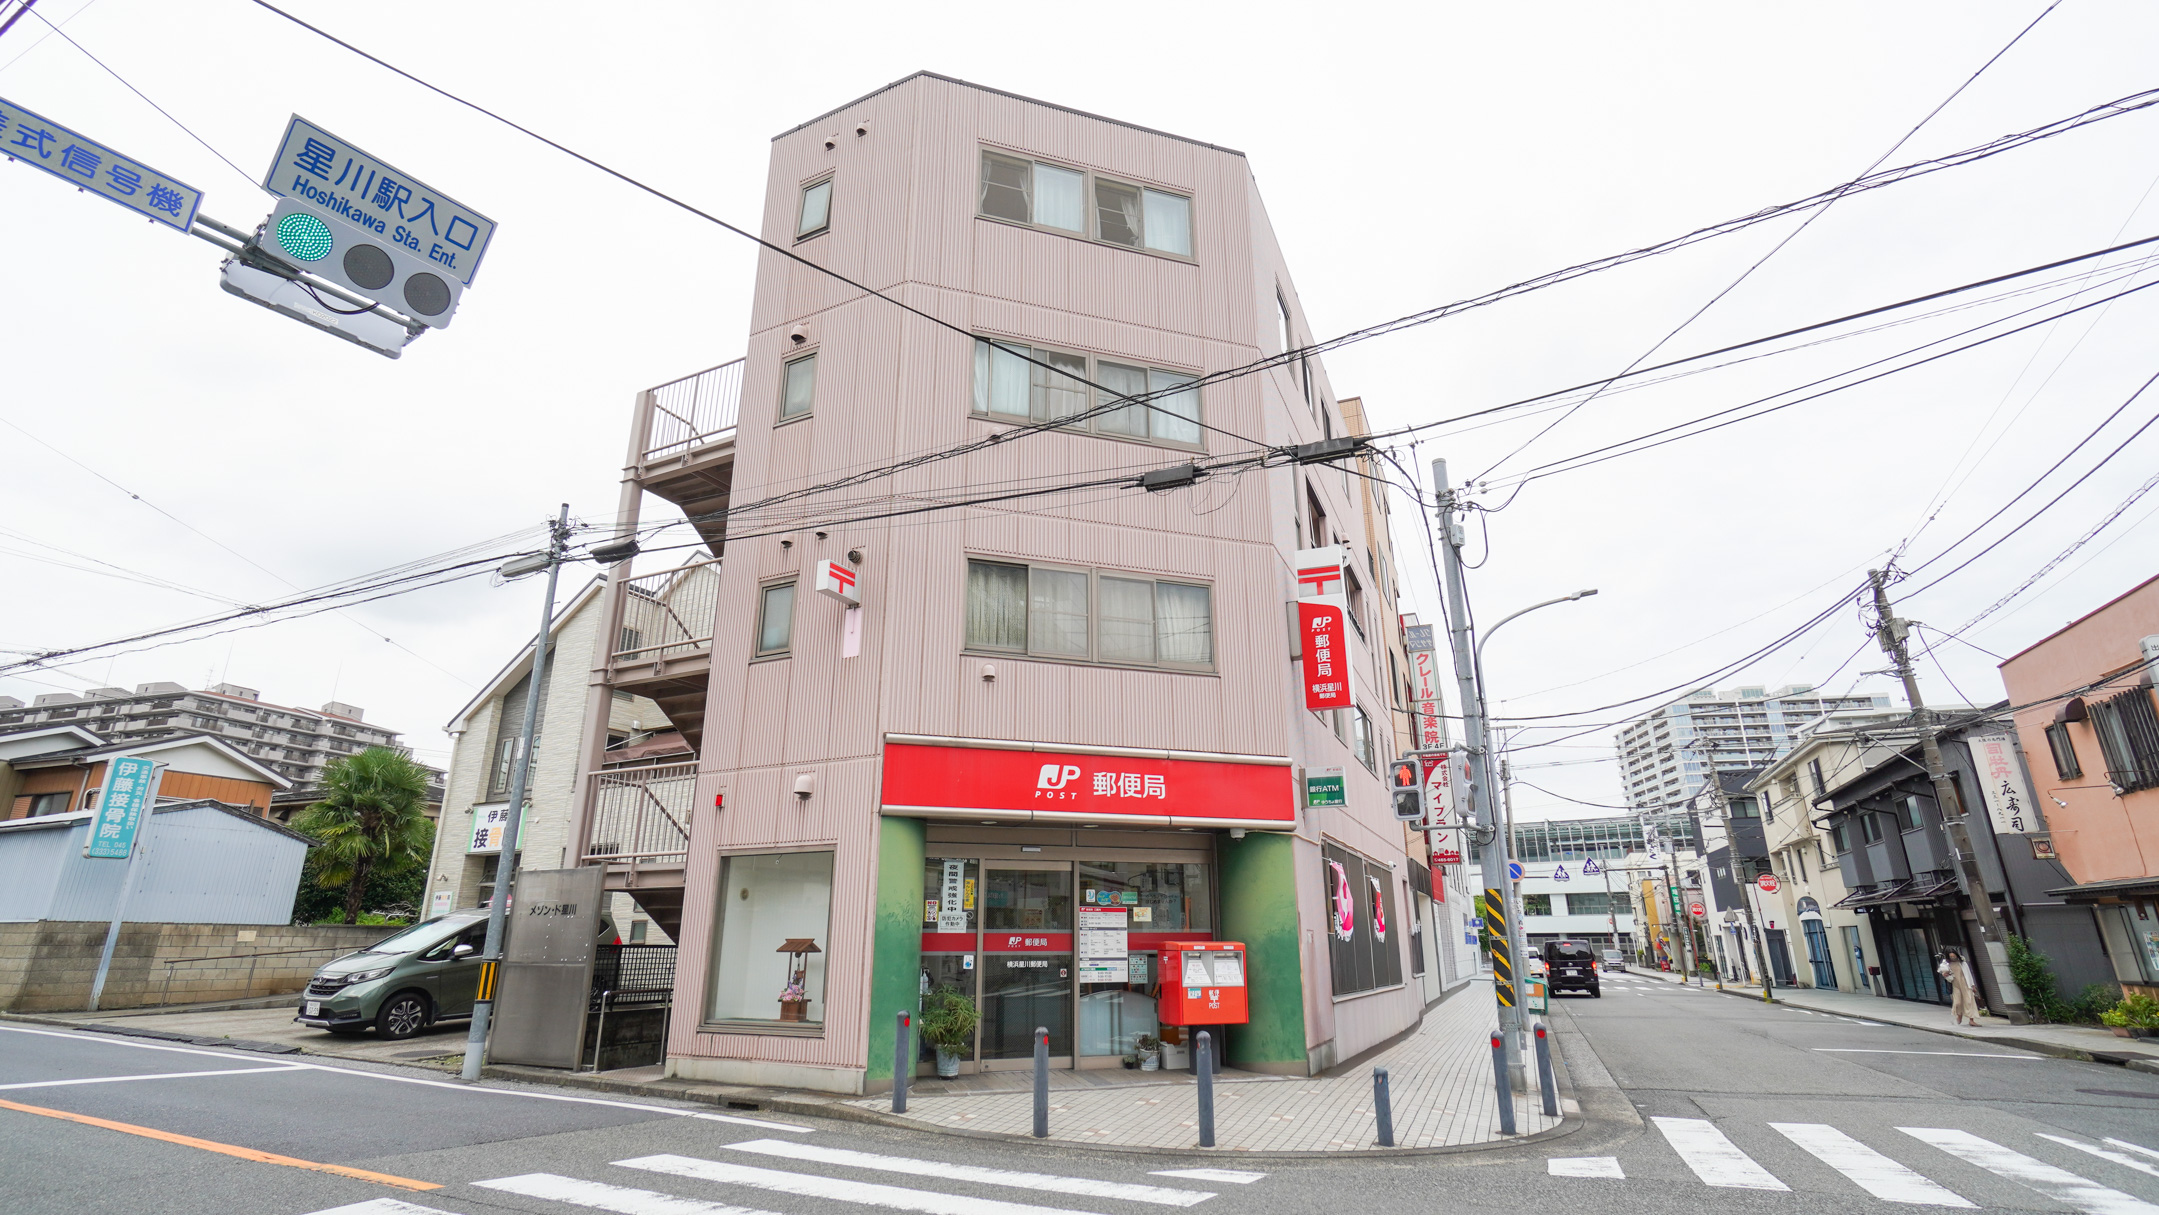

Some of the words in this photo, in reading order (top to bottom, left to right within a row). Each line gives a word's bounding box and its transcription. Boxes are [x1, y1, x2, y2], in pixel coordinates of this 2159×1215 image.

[294, 137, 479, 251] 星川駅入口
[292, 175, 386, 235] Hoshikawa
[392, 224, 422, 253] Sta.
[428, 242, 457, 270] Ent.
[1312, 616, 1332, 629] JP
[1315, 634, 1332, 677] 郵便局
[1416, 653, 1433, 699] クレール
[1312, 682, 1342, 694] 横浜星川
[1421, 702, 1439, 744] 音楽院
[1986, 742, 2013, 779] 司牡丹
[1037, 764, 1081, 790] JP
[1093, 772, 1166, 799] 郵便局
[1440, 764, 1449, 787] 株式会社
[1035, 790, 1077, 800] POST
[1309, 784, 1339, 793] 銀行ATM
[99, 762, 138, 839] 伊藤接骨院
[2001, 780, 2025, 832] 広寿司
[488, 808, 509, 823] 伊藤
[98, 840, 110, 848] TEL
[473, 827, 503, 848] 接骨
[1008, 936, 1022, 945] JP
[1024, 938, 1048, 947] 郵便局
[1006, 960, 1048, 969] 横浜星川郵便局
